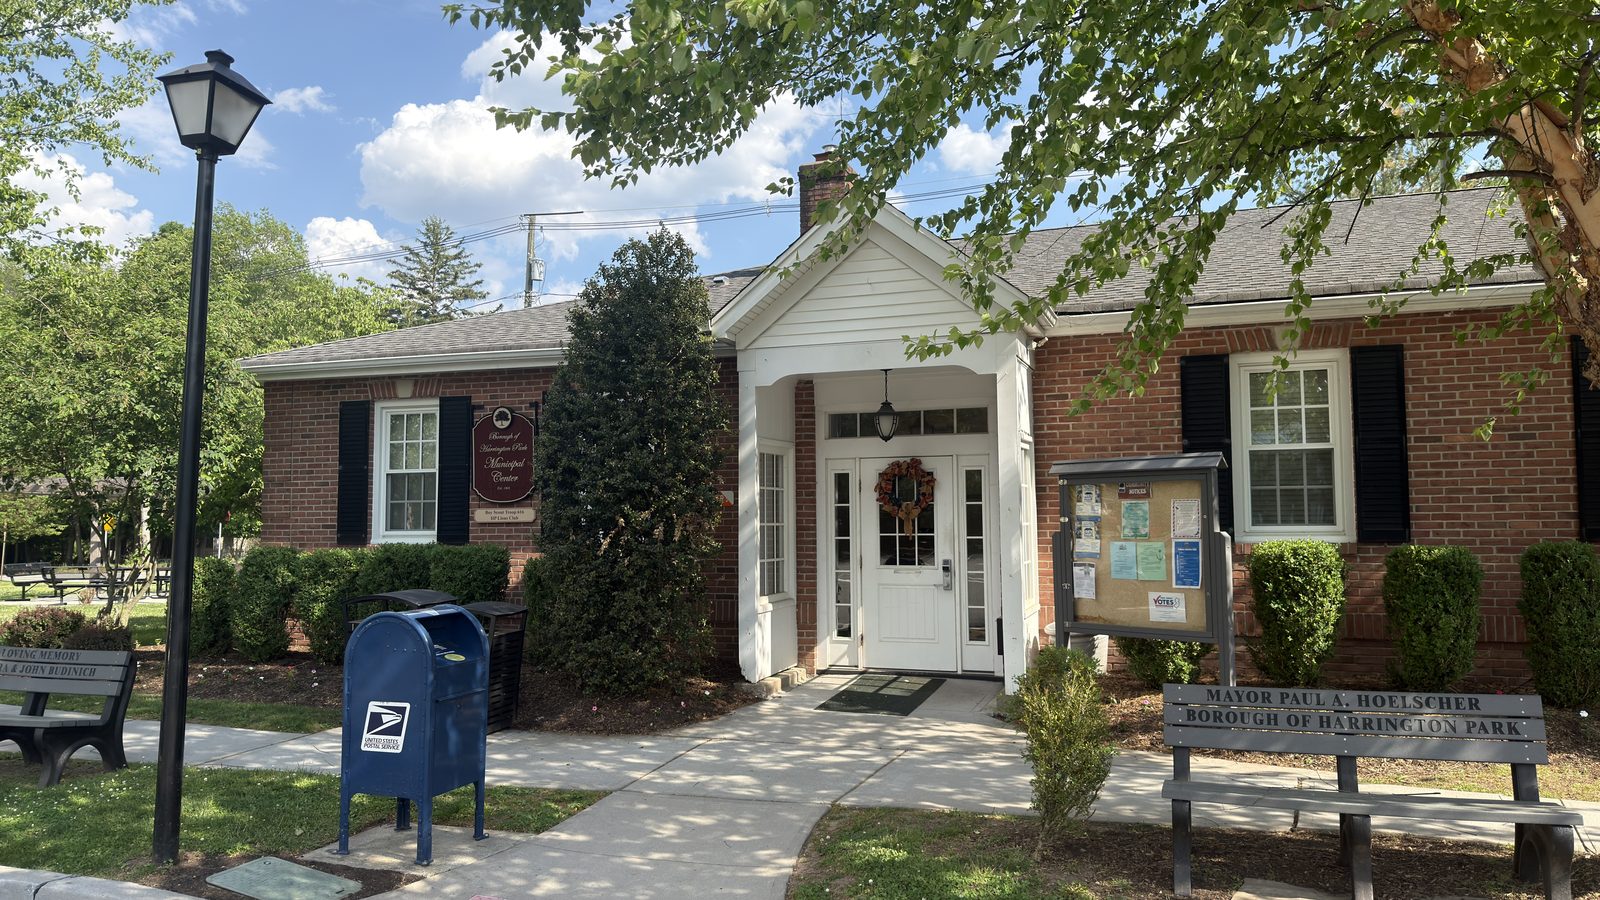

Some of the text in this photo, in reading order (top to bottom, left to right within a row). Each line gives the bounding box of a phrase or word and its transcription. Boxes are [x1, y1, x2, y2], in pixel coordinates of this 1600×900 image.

[488, 432, 521, 442] Borough of
[480, 443, 528, 454] Harrington Park
[484, 457, 526, 471] Municipal
[491, 471, 519, 483] Center
[1153, 595, 1174, 605] VOTES
[2, 649, 81, 661] LOVING MEMORY
[11, 664, 18, 673] &
[20, 664, 46, 675] JOHN
[48, 666, 97, 677] BUDINICH
[1206, 689, 1482, 711] MAYOR PAUL A. HOELSCHER
[1186, 709, 1522, 736] BOROUGH OF HARRINGTON PARK
